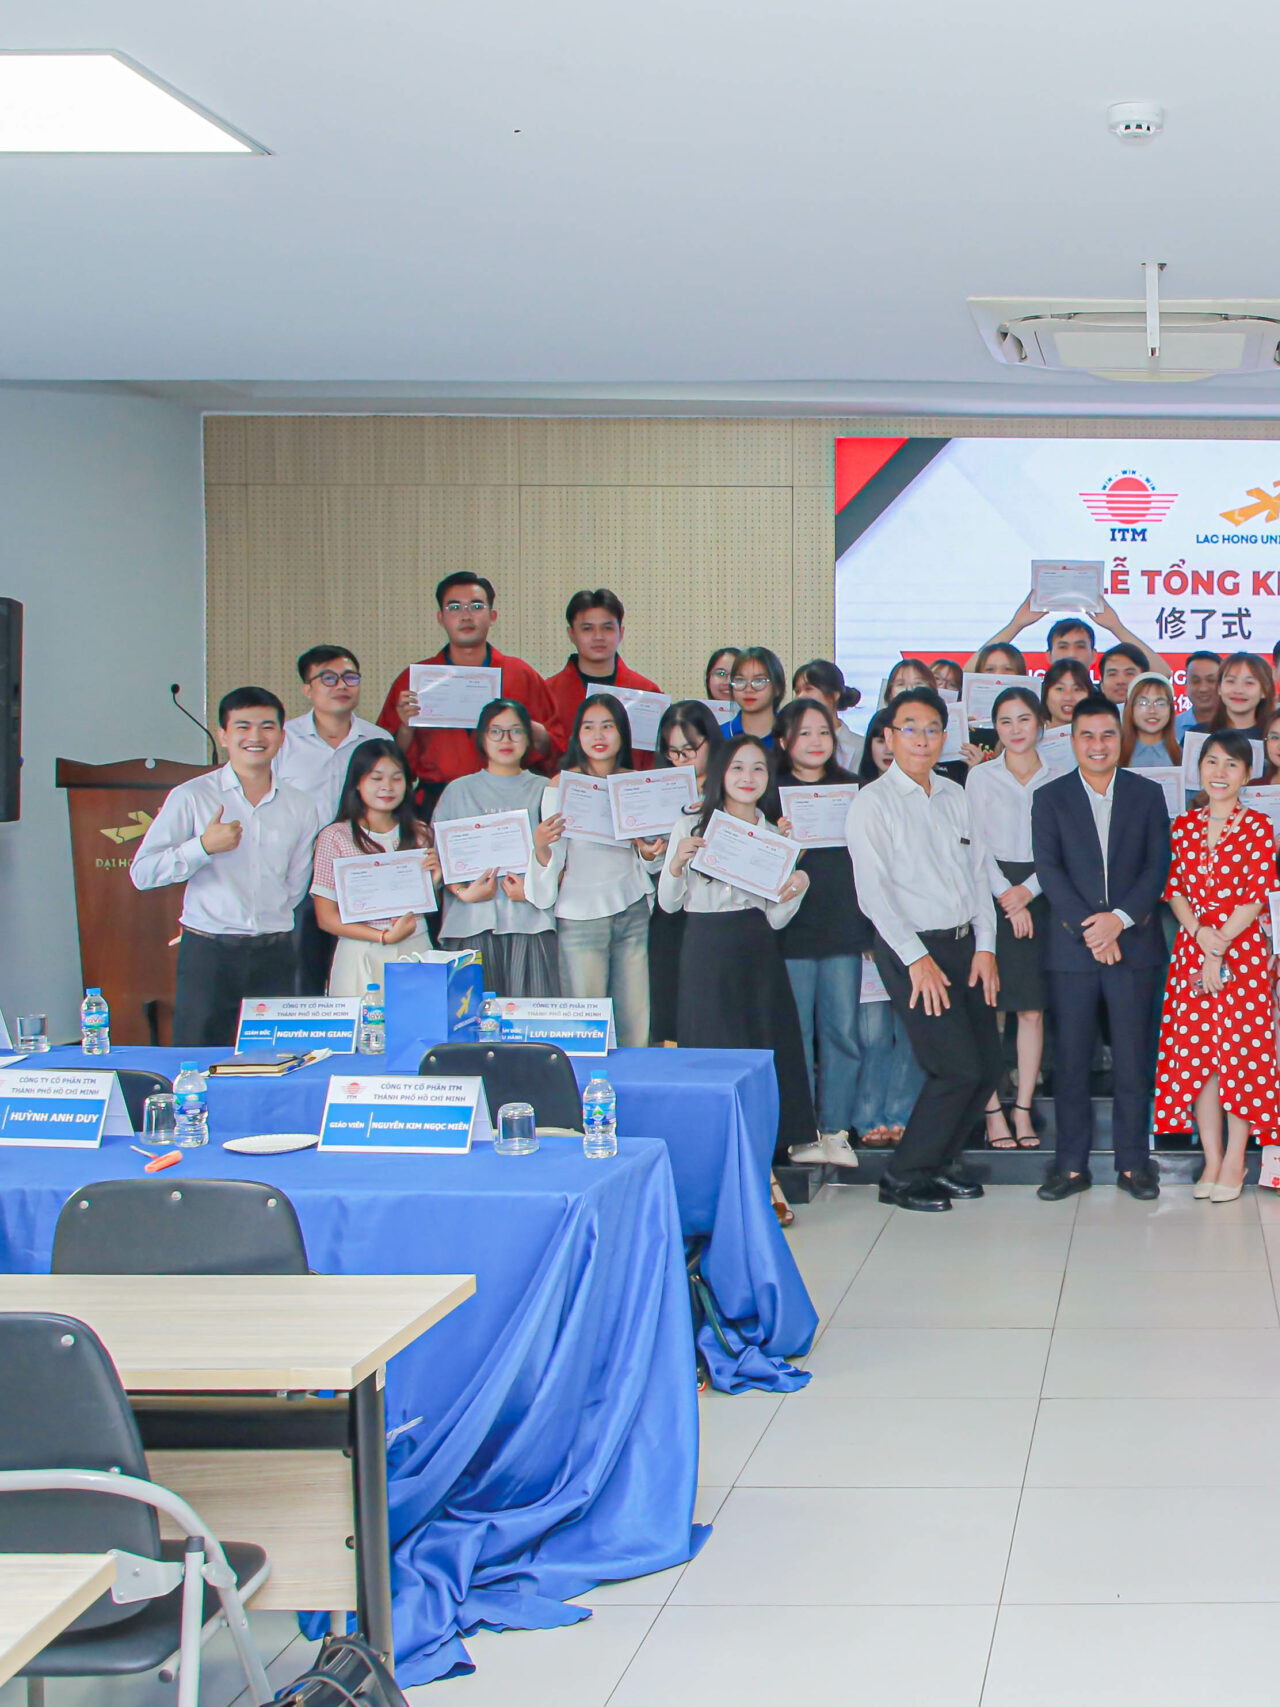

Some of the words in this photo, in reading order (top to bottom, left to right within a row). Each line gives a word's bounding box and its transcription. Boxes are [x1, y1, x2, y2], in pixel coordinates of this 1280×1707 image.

[1110, 528, 1148, 542] ITM
[1196, 534, 1220, 544] LAC
[1222, 534, 1258, 545] HONG
[1104, 556, 1130, 595] Ễ
[1140, 558, 1241, 596] TỔNG
[1155, 607, 1253, 641] 修了式
[310, 1030, 326, 1038] KIM
[327, 1030, 353, 1038] GIANG
[549, 1030, 574, 1038] DANH
[19, 1076, 39, 1084] CÔNG
[380, 1082, 401, 1090] CÔNG
[10, 1109, 49, 1122] HUỲNH
[49, 1113, 74, 1123] ANH
[75, 1113, 100, 1124] DUY
[405, 1122, 422, 1130] KIM
[423, 1122, 447, 1131] NGỌC
